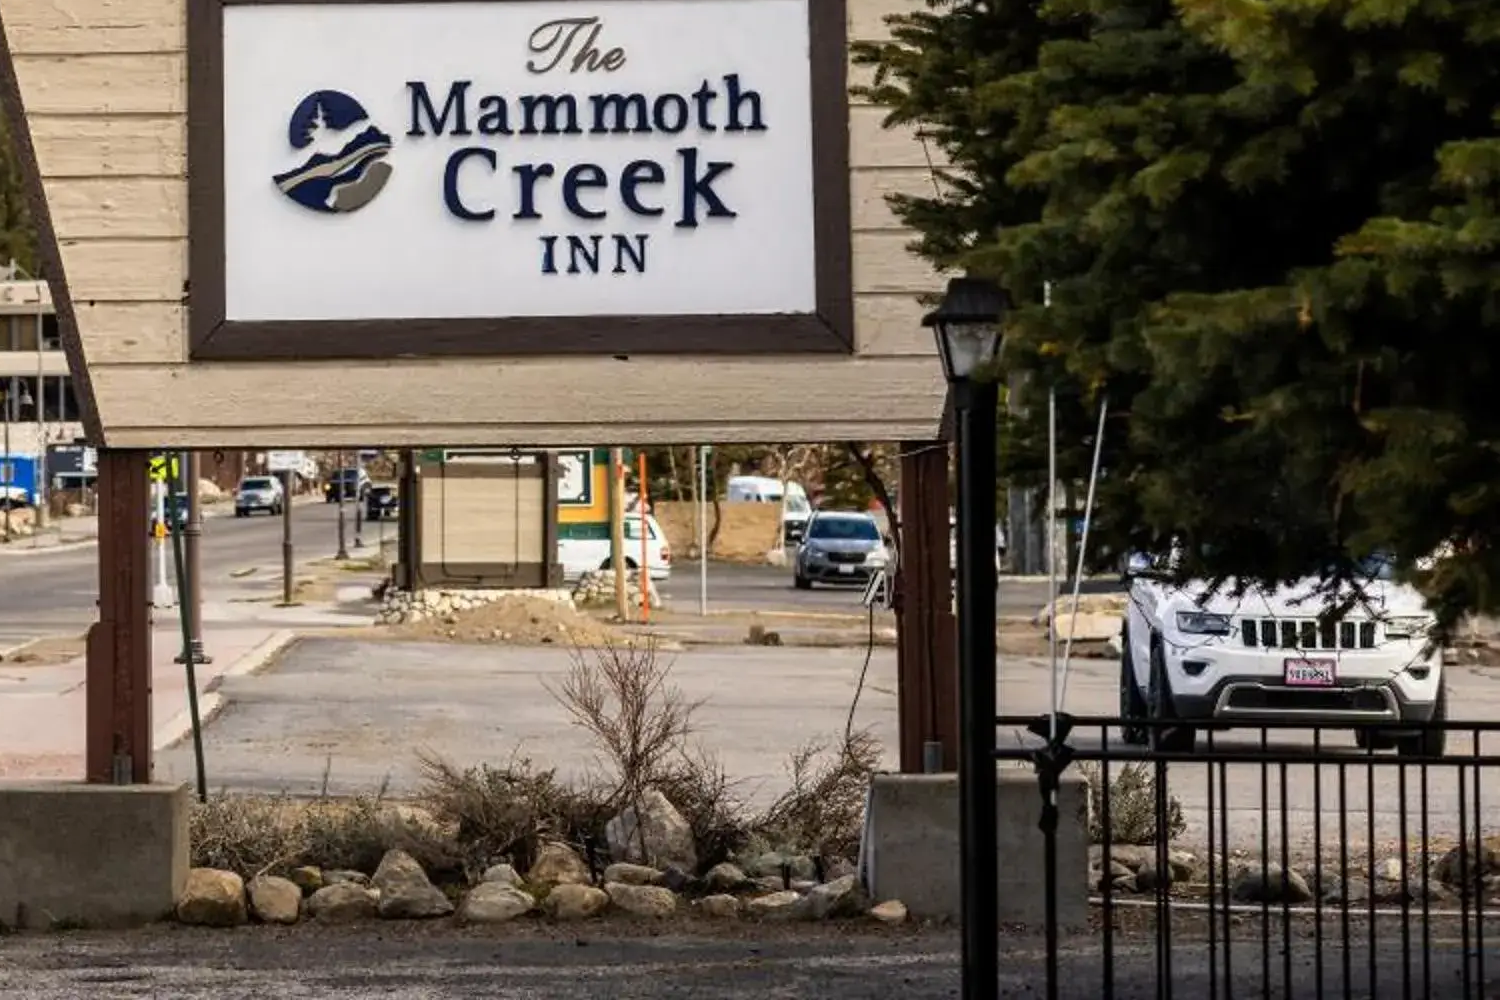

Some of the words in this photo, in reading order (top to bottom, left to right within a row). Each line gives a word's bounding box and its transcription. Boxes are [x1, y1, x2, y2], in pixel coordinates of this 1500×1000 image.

[526, 16, 626, 74] The
[405, 74, 767, 138] Mammoth
[443, 147, 737, 229] Creek
[539, 234, 649, 274] INN
